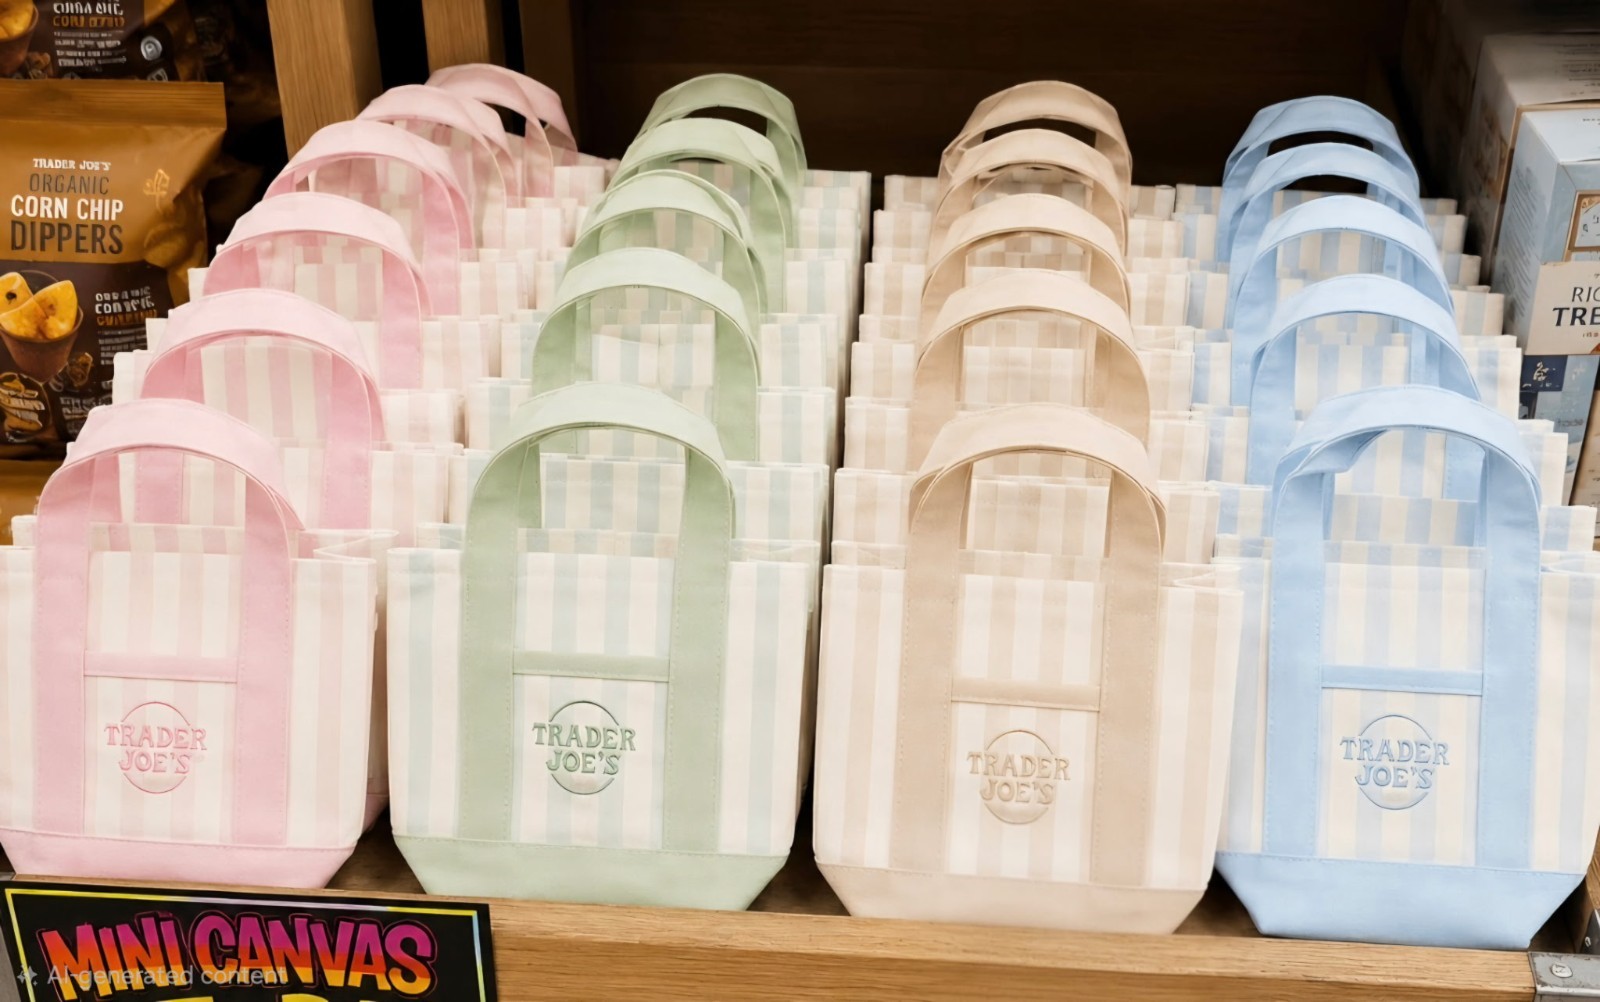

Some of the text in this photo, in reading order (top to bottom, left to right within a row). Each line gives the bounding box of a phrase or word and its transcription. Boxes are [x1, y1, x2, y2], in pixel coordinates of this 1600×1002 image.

[33, 158, 76, 170] TRADER
[29, 173, 110, 195] ORGANIC
[11, 194, 124, 221] CORN CHIP
[11, 220, 124, 255] DIPPERS
[104, 722, 208, 751] TRADER
[532, 722, 637, 752] TRADER
[118, 750, 193, 775] JOE'S
[545, 749, 623, 776] JOE'S
[1340, 735, 1451, 766] TRADER
[966, 751, 1072, 781] TRADER
[1354, 764, 1434, 789] JOE'S
[979, 779, 1056, 806] JOE'S
[39, 912, 434, 1000] MINI CANVAS
